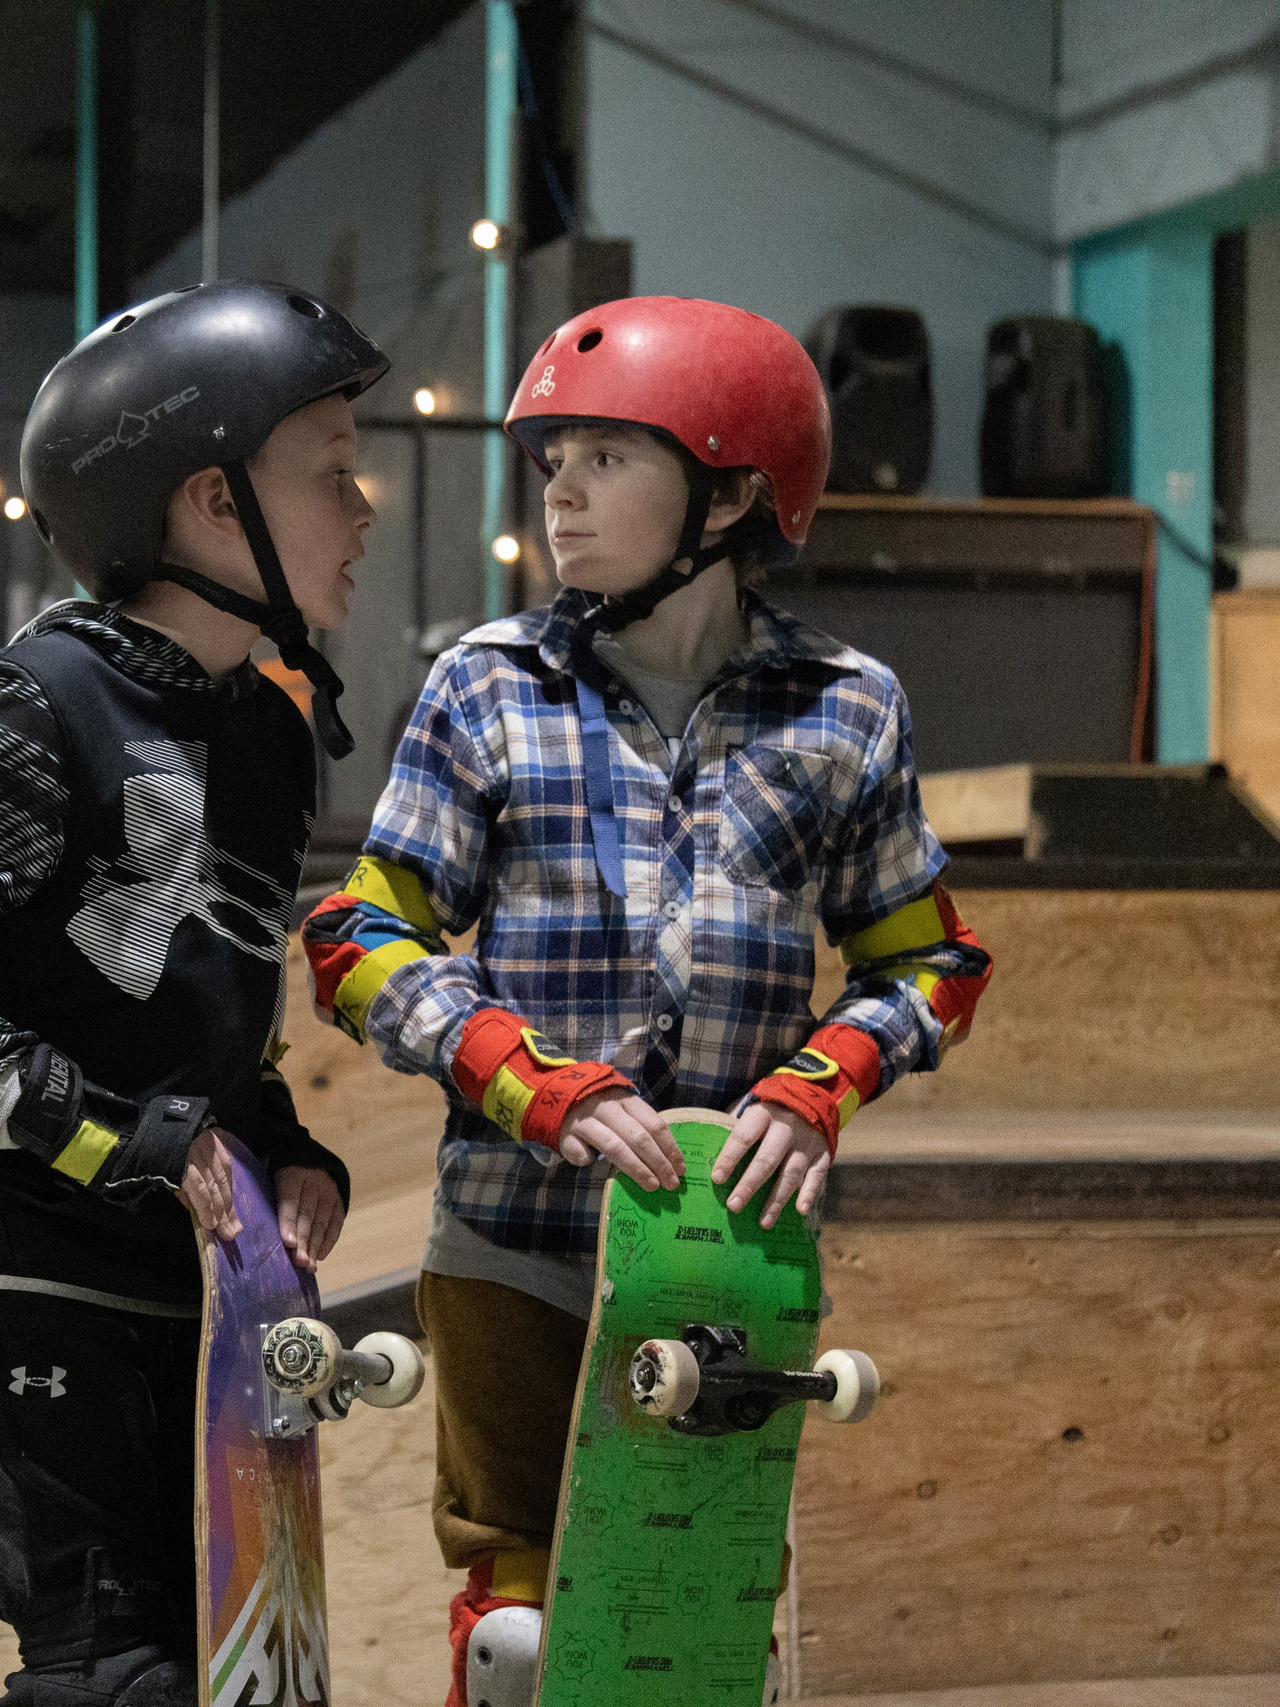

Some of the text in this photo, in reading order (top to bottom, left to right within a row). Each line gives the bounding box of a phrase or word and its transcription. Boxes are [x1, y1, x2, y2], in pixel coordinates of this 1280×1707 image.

[71, 385, 200, 476] PRO TEC
[41, 1051, 70, 1102] RENTAL
[170, 1099, 190, 1112] R
